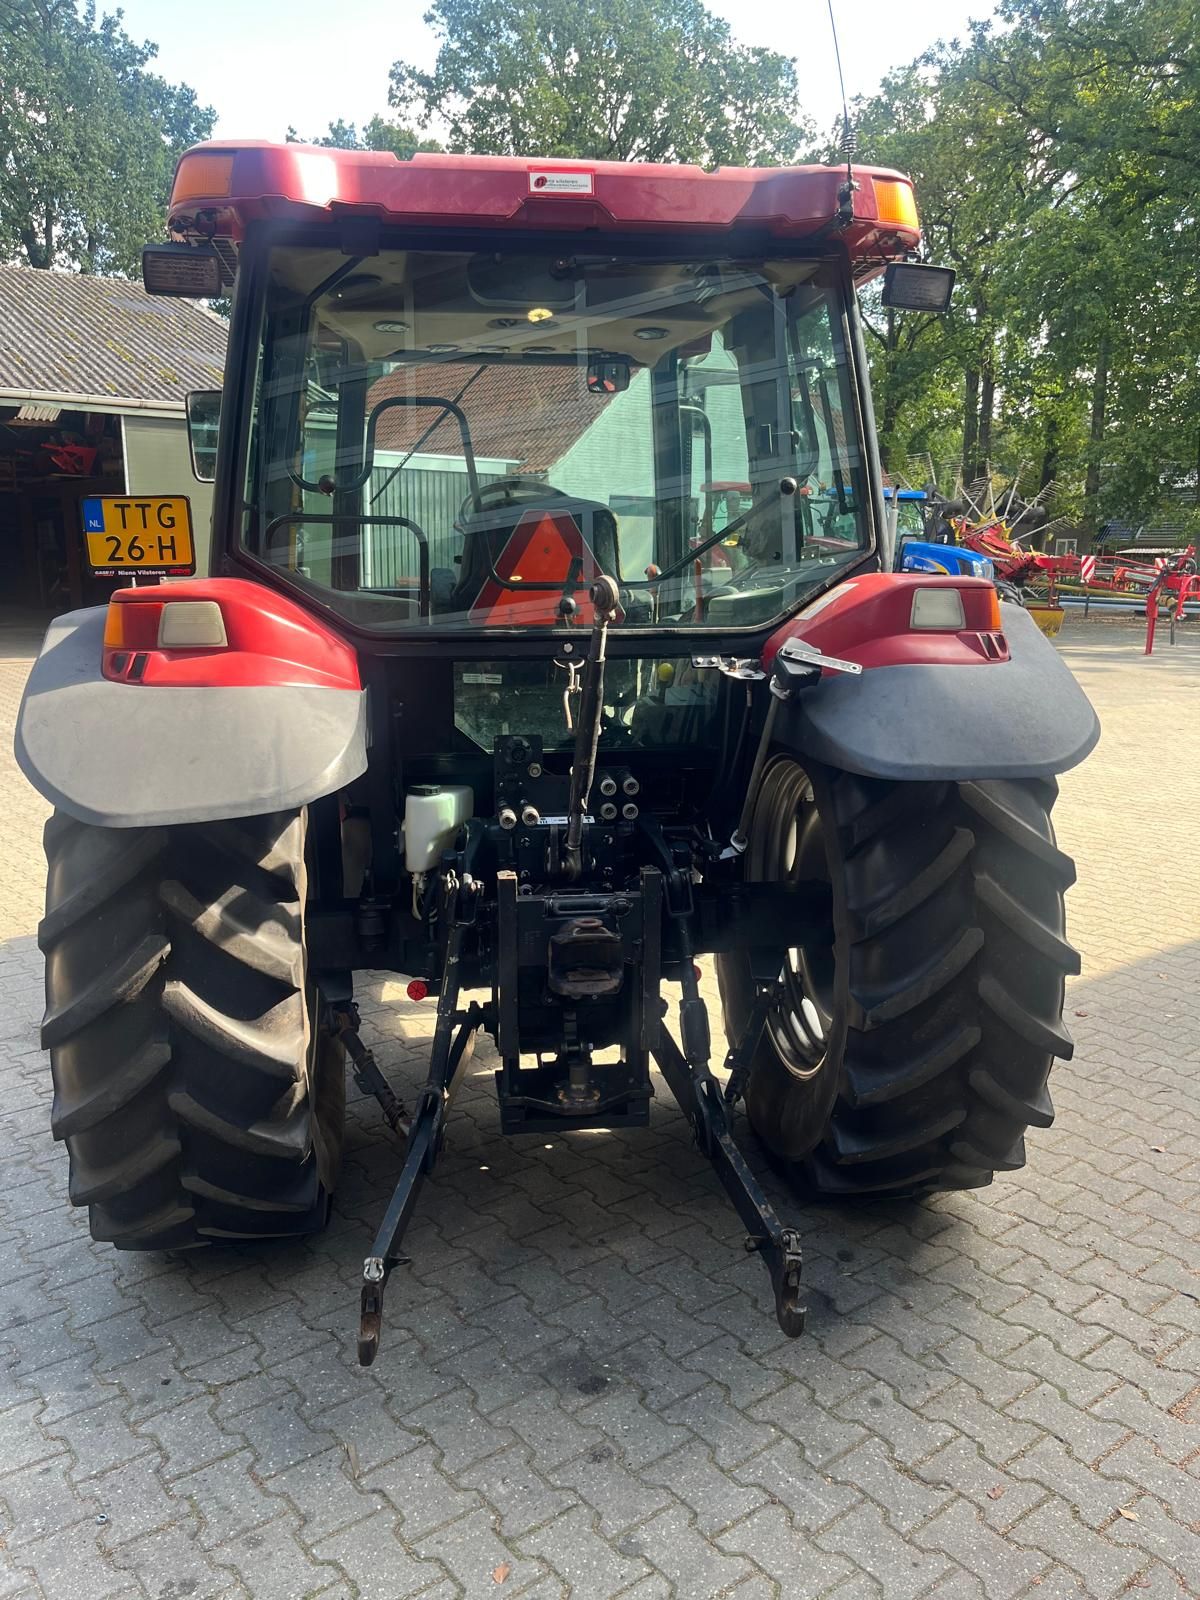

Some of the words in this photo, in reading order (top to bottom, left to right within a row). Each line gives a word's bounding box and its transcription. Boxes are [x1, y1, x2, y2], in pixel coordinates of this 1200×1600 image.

[89, 519, 102, 528] NL
[114, 503, 176, 529] TTG
[105, 535, 177, 562] 26-H
